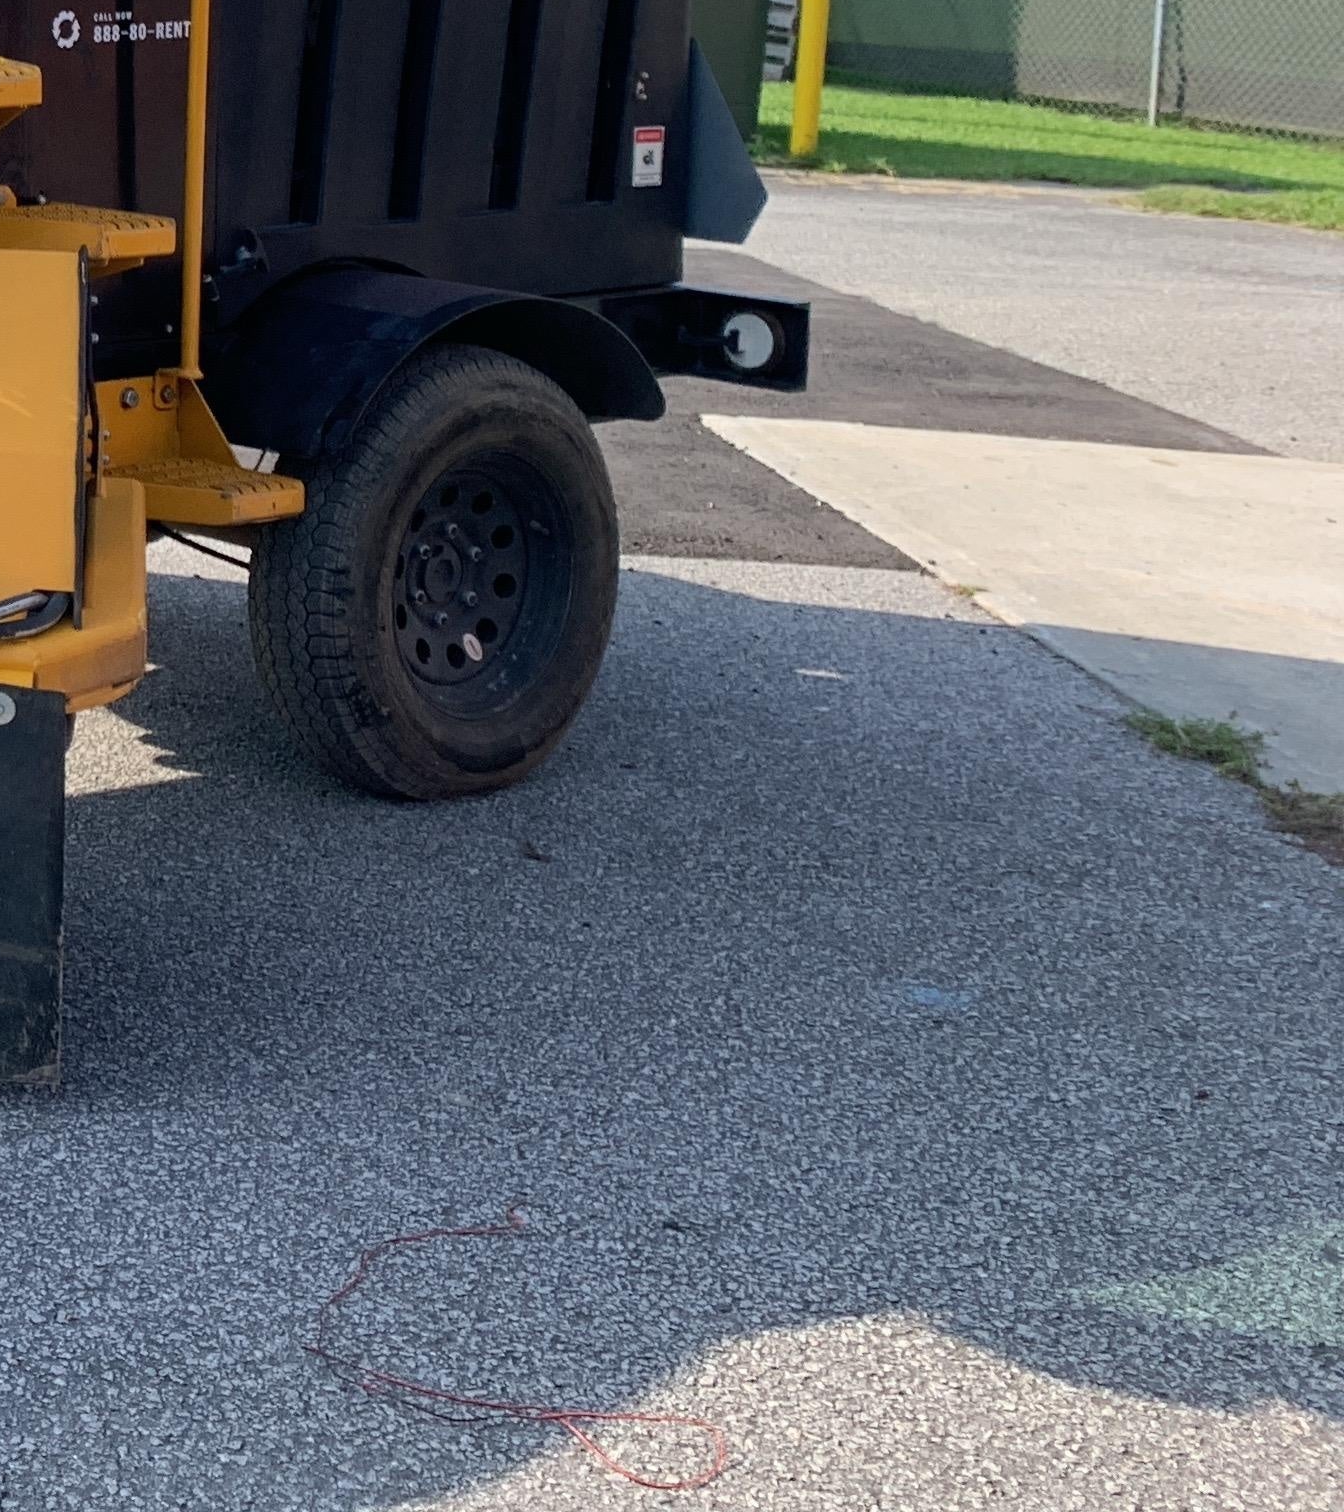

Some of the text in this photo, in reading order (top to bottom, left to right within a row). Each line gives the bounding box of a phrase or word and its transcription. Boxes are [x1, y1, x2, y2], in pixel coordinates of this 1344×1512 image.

[93, 11, 132, 22] CALL NOW
[93, 21, 192, 43] 888-80-RENT
